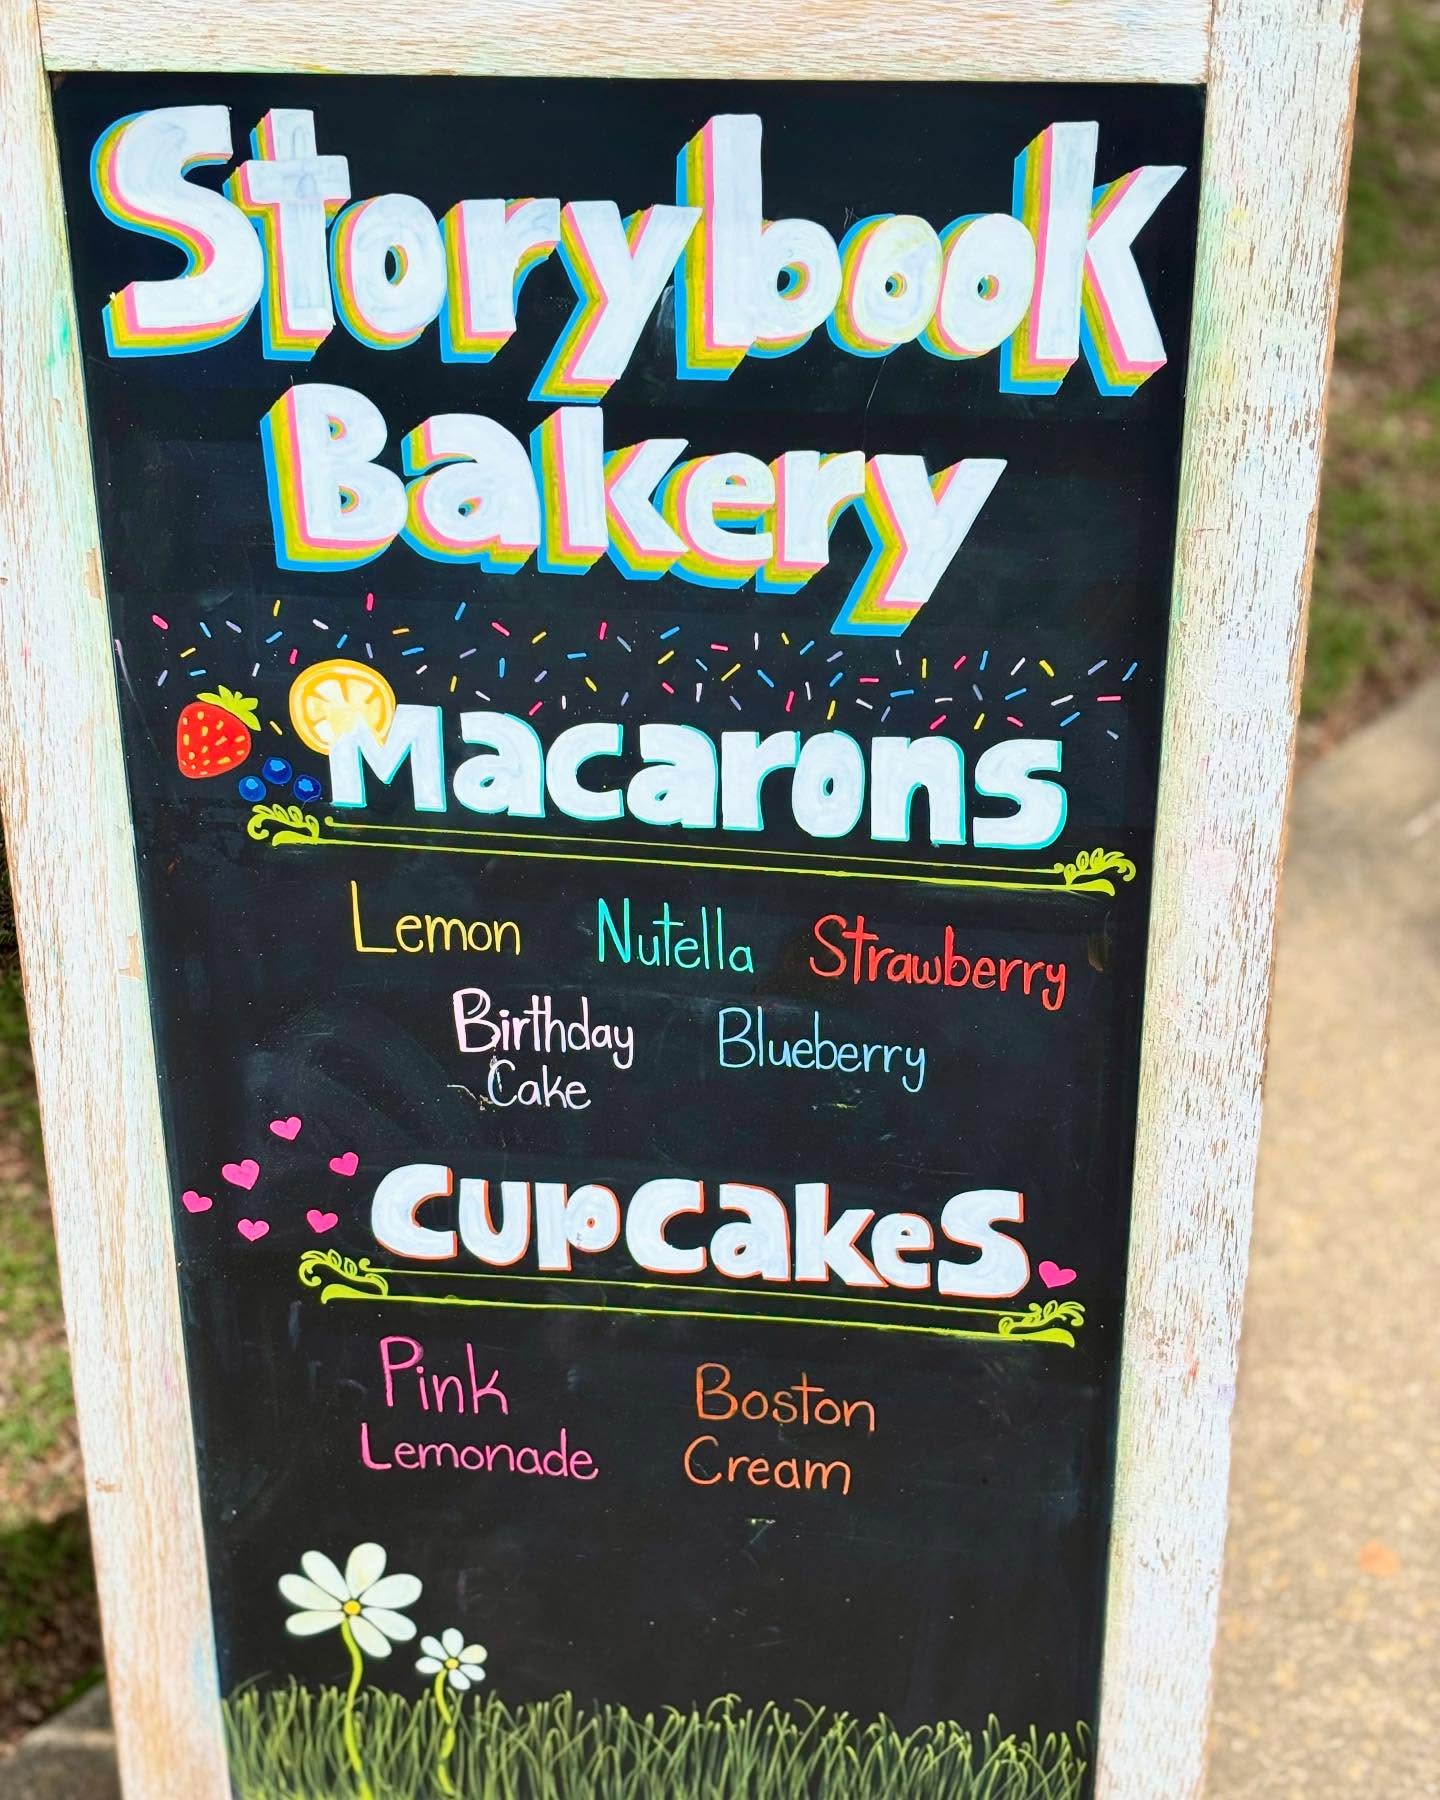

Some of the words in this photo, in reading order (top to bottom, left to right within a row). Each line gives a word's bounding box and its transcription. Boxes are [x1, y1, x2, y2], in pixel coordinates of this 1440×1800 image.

[90, 104, 1187, 403] Storybook
[260, 383, 1008, 637] Bakery
[327, 704, 1068, 850] Macarons
[351, 881, 521, 956] Lemon
[597, 897, 755, 974] Nutella
[809, 914, 1067, 1011] Strawberry
[452, 987, 634, 1070] Birthday
[718, 1006, 926, 1092] Blueberry
[487, 1058, 592, 1110] Cake
[379, 1335, 509, 1415] Pink
[695, 1362, 875, 1432] Boston
[360, 1422, 599, 1481] Lemonade
[683, 1435, 851, 1496] Cream
